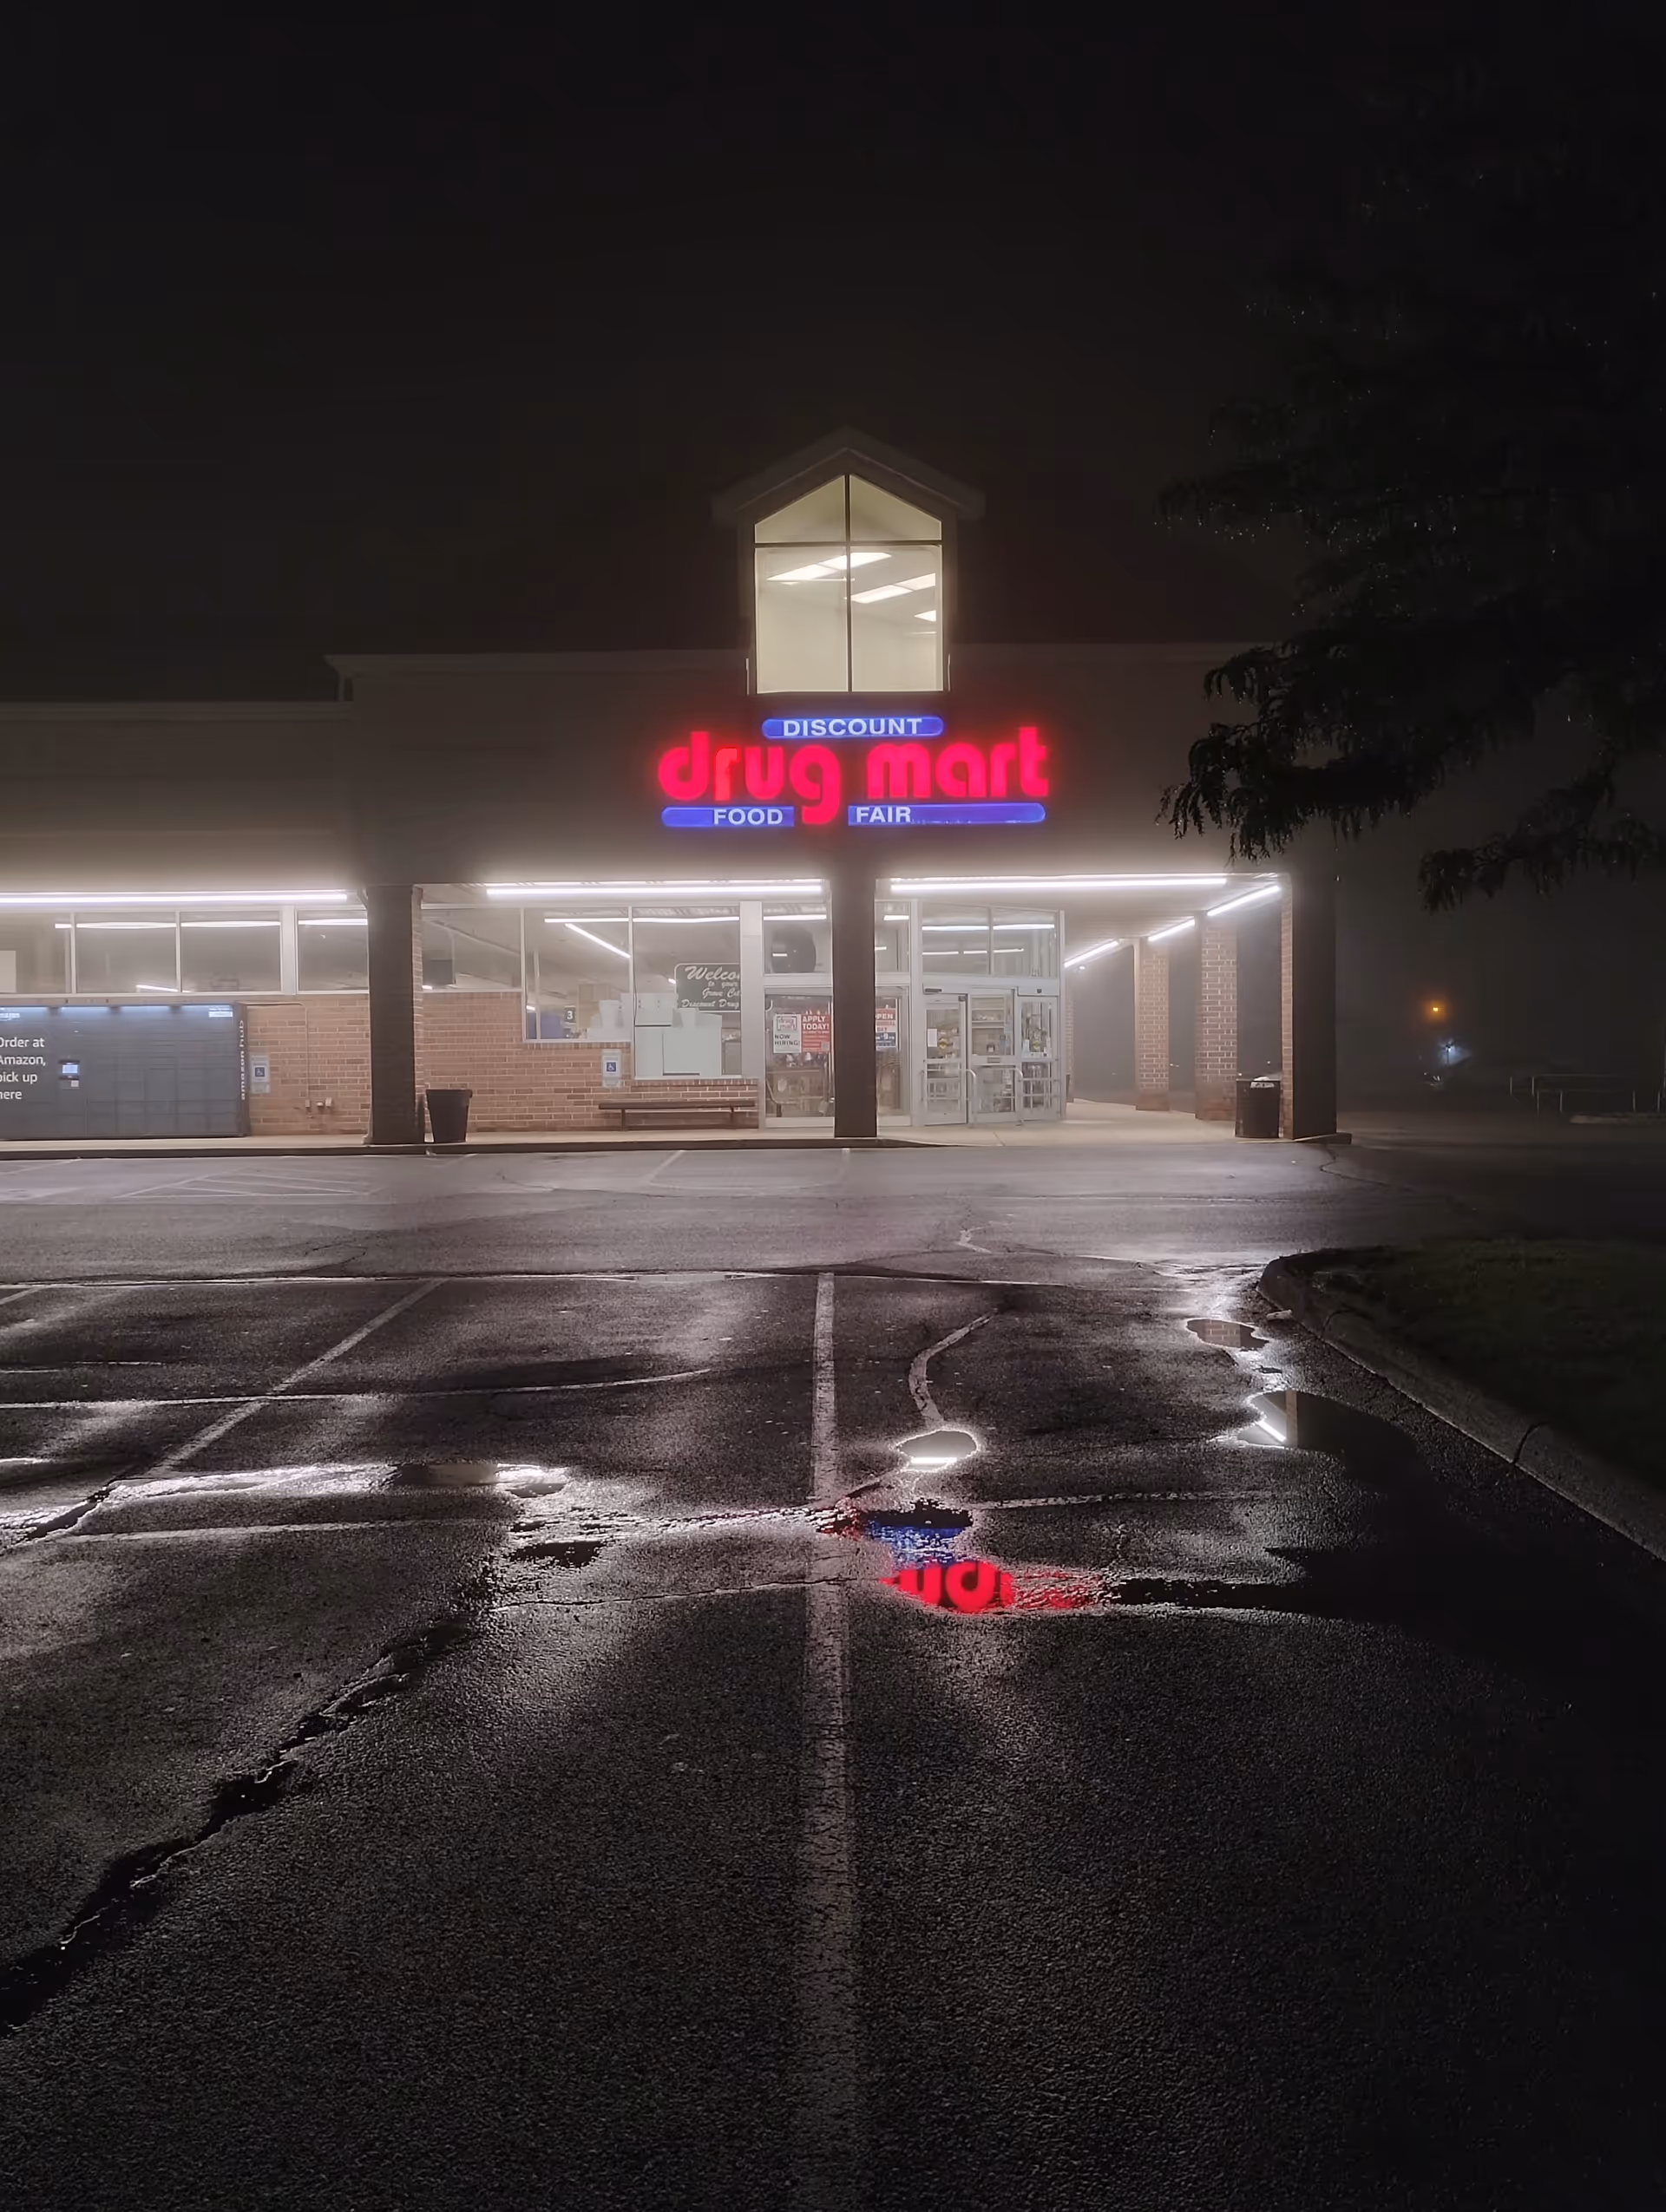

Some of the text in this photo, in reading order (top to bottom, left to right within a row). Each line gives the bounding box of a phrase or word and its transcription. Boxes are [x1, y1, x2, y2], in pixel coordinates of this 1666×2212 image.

[783, 718, 922, 736] DISCOUNT
[659, 726, 1049, 825] drug mart
[713, 806, 912, 825] FOOD FAIR
[685, 965, 740, 980] Welco
[727, 987, 740, 998] Cit
[718, 999, 739, 1009] Drug
[567, 1011, 574, 1019] 3
[32, 1037, 45, 1047] at
[23, 1074, 38, 1084] up
